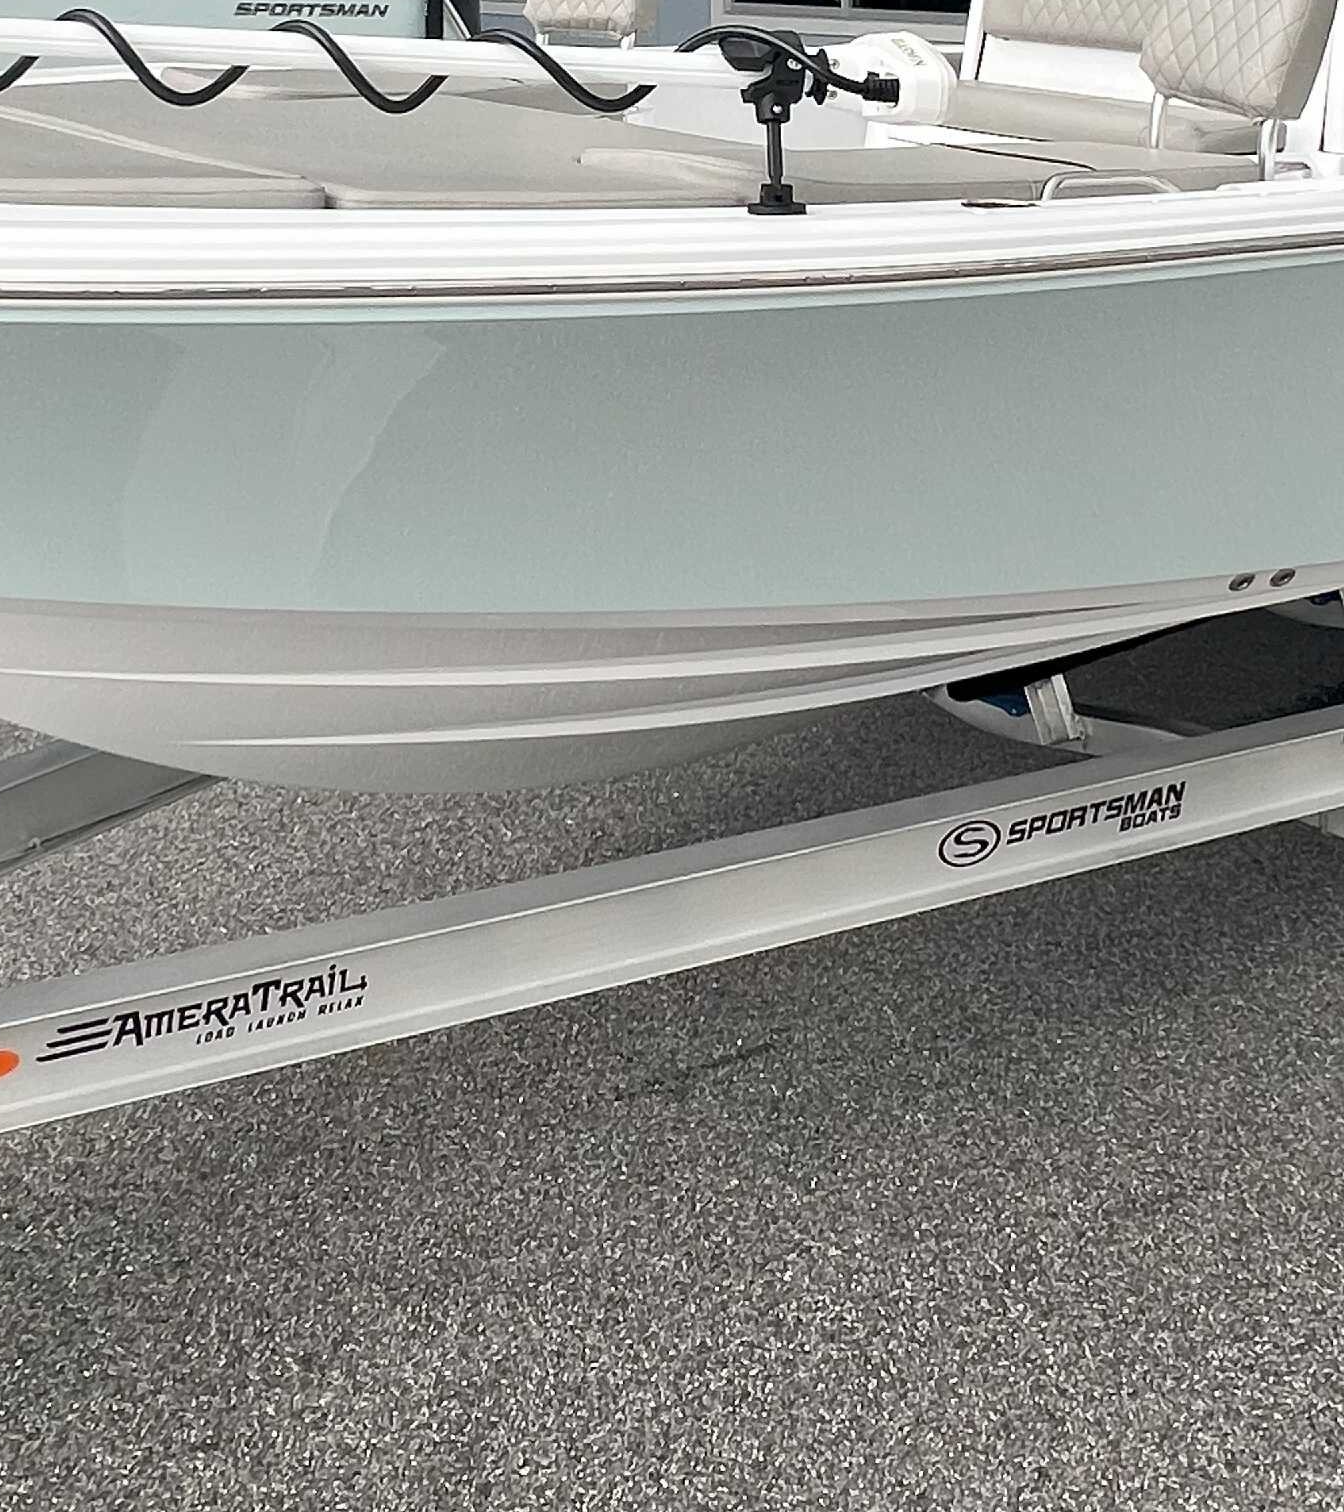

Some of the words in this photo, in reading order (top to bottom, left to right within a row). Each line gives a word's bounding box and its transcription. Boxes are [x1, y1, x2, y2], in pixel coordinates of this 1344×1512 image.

[234, 1, 390, 18] SPORTSMAN
[1006, 781, 1186, 845] SPORTSMAN
[1118, 804, 1182, 832] BOATS
[196, 1025, 235, 1045] LOAD
[247, 1010, 307, 1034] LAUNCH
[317, 995, 364, 1016] RELAX
